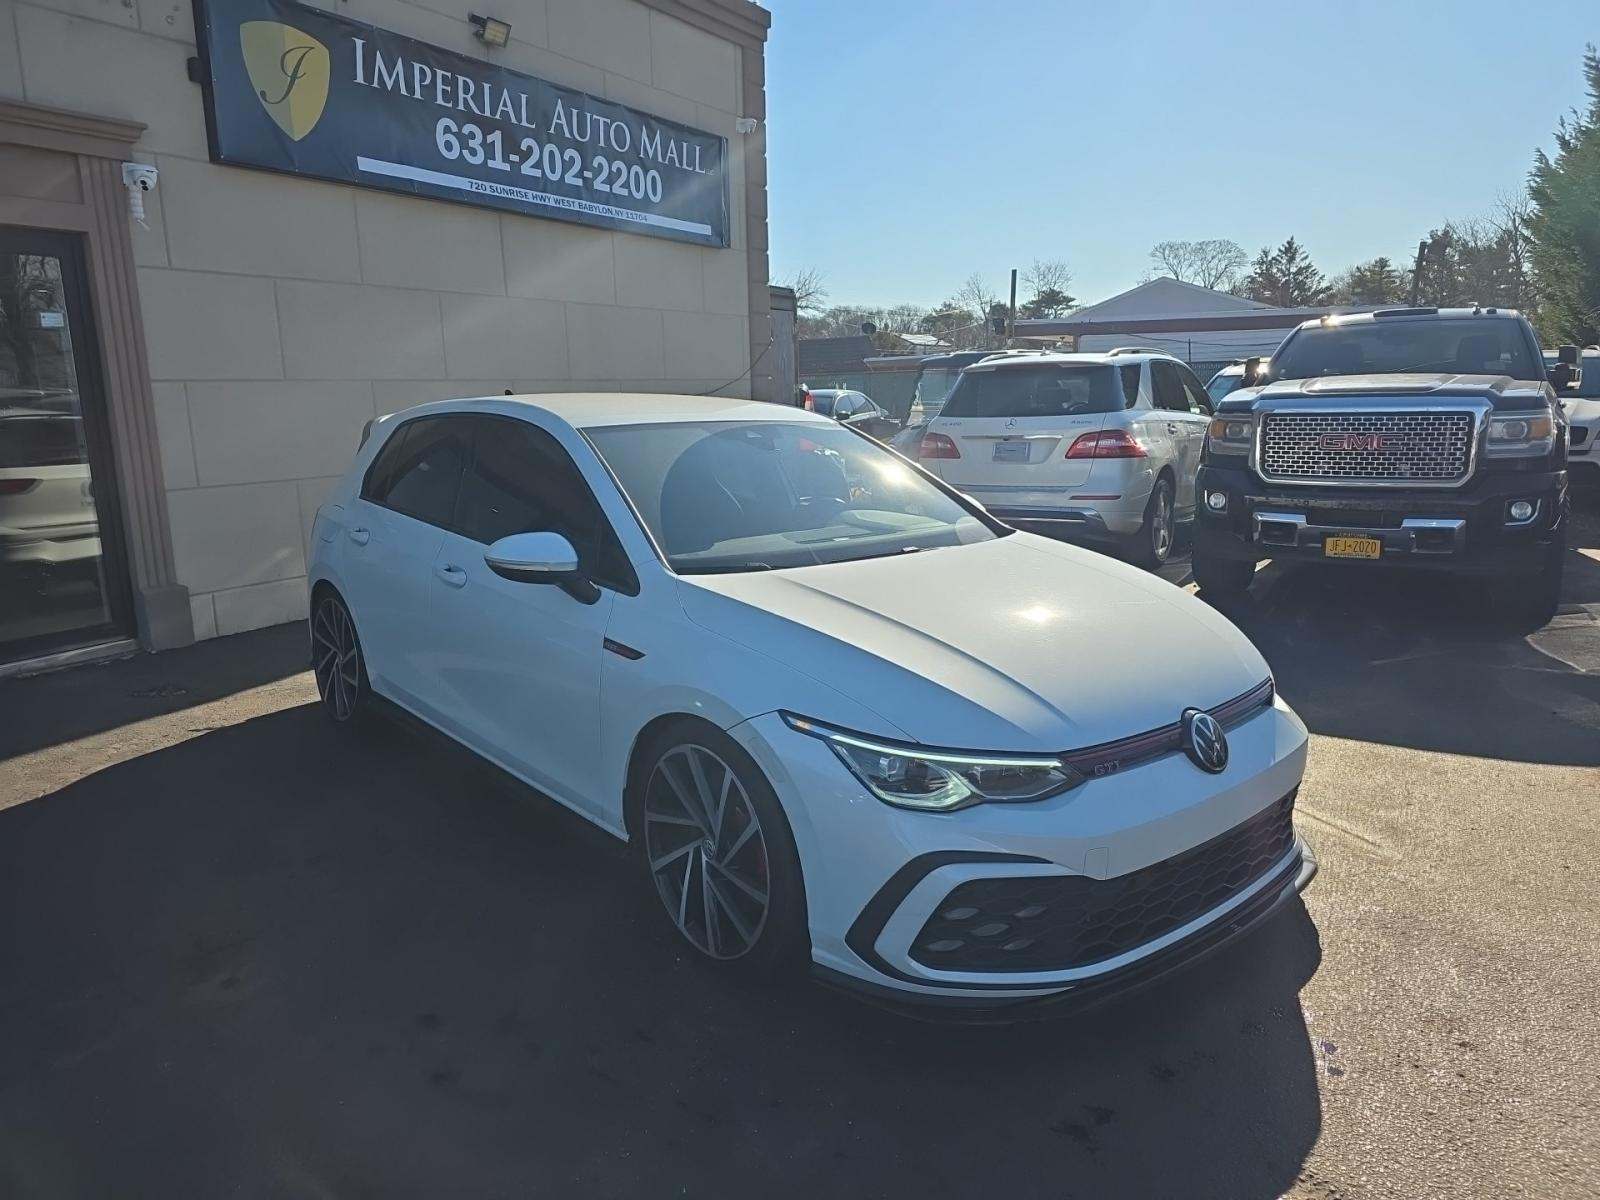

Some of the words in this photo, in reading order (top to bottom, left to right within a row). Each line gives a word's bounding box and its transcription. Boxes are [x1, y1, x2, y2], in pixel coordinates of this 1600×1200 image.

[435, 117, 663, 203] 631-202-2200
[467, 180, 487, 192] 720
[489, 183, 530, 200] SUNRISE
[531, 193, 552, 205] HWY
[553, 197, 576, 210] WEST
[625, 209, 648, 223] 11704
[1320, 433, 1404, 450] GMC
[1094, 759, 1120, 776] GTI
